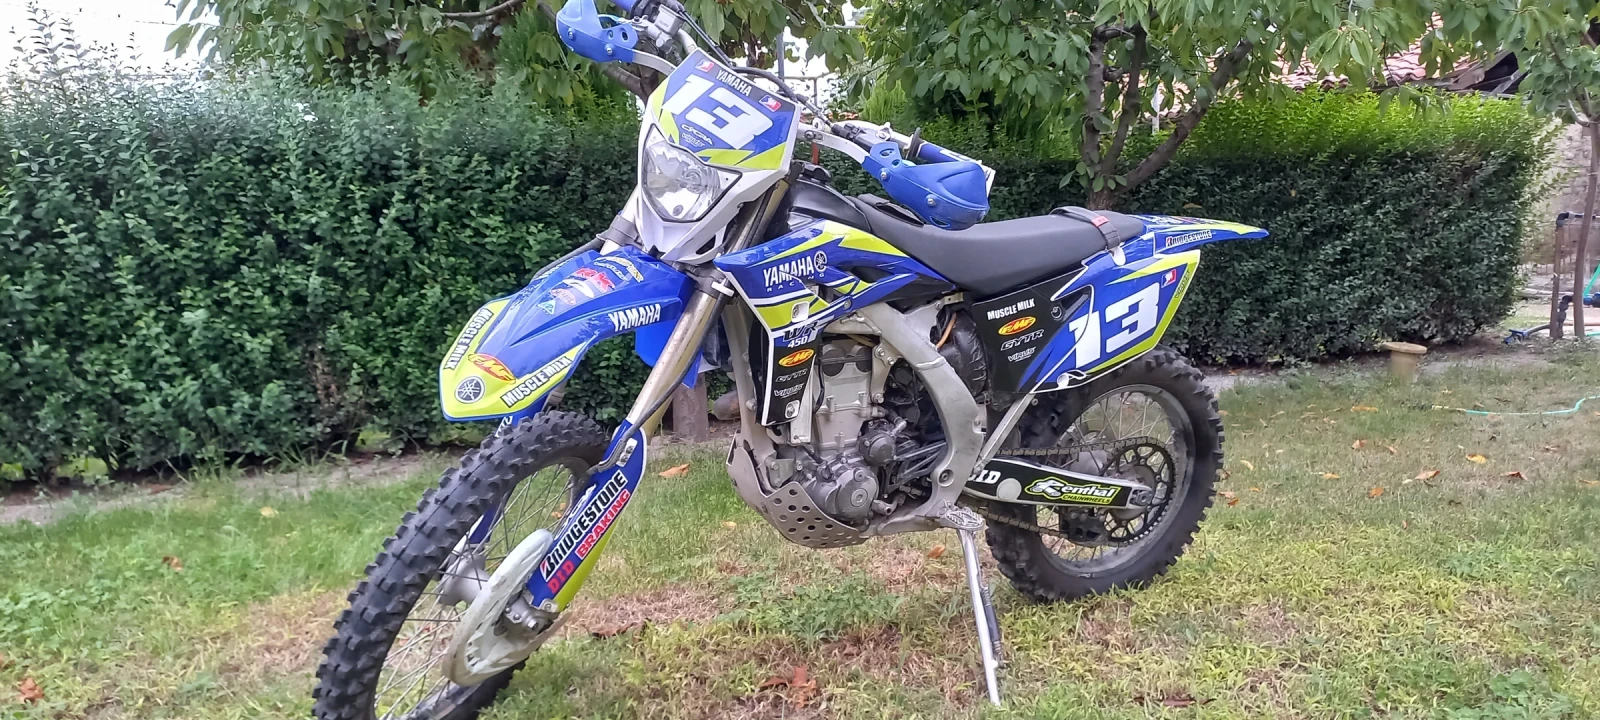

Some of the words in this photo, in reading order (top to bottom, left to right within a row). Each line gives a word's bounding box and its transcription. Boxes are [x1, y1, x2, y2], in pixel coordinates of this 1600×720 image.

[715, 69, 753, 97] YAMAHA
[662, 73, 773, 150] 13
[763, 255, 815, 288] YAMAHA
[607, 303, 662, 333] YAMAHA
[987, 304, 1018, 321] MUSCLE
[1016, 297, 1036, 311] MILK
[458, 307, 494, 349] MUSCLE
[998, 316, 1036, 335] FMF
[1068, 282, 1161, 368] 13
[443, 342, 470, 371] MILK
[787, 335, 809, 349] 450
[778, 348, 815, 368] FMF
[500, 371, 549, 408] MUSCLE
[545, 355, 573, 379] MILK
[967, 469, 1002, 485] ID
[1062, 494, 1112, 504] CHAINWHEELS
[539, 470, 629, 583] BRIDGESTONE
[547, 560, 576, 595] DID
[576, 488, 631, 561] BRAKING
